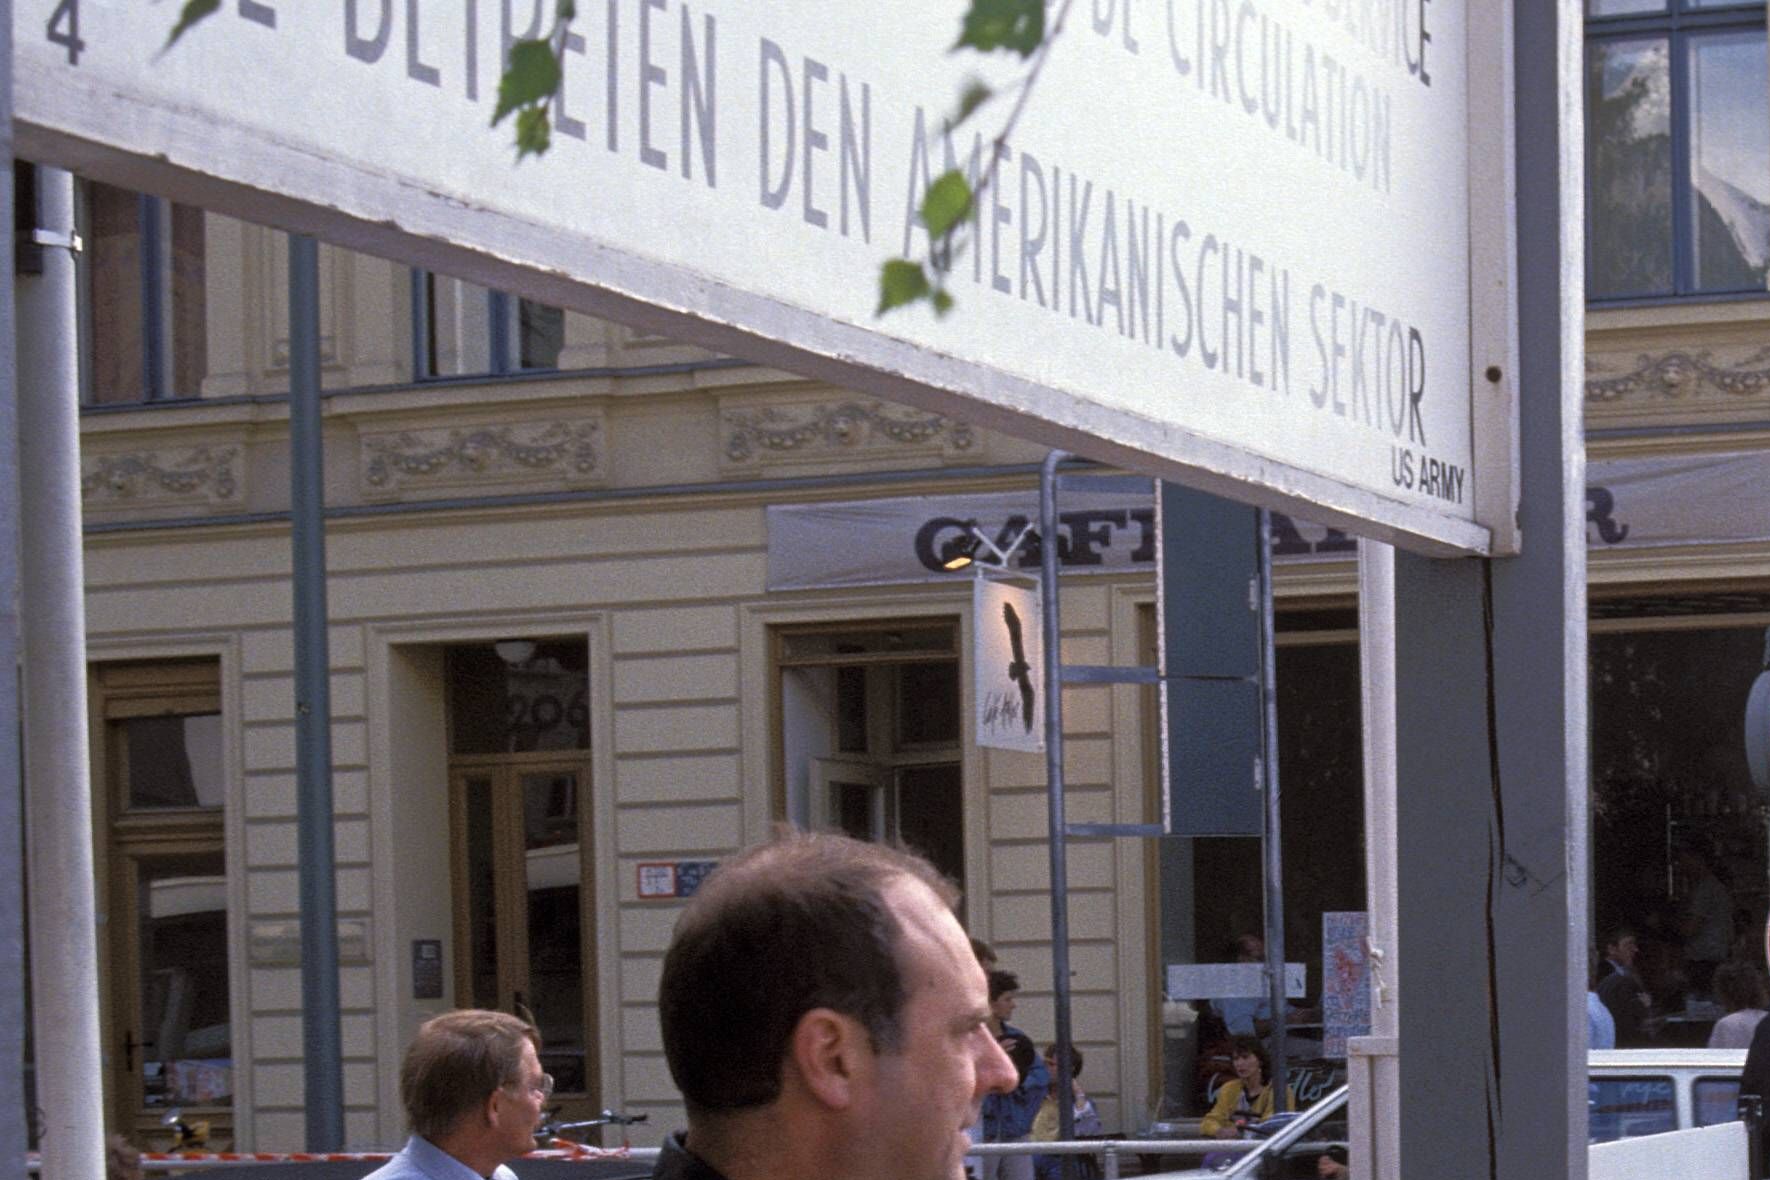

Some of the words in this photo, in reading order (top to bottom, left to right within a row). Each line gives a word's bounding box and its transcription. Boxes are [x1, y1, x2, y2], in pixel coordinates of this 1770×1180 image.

[345, 0, 717, 188] ETEN
[760, 37, 871, 244] DEN
[1309, 283, 1427, 447] SEKTOR
[1392, 445, 1414, 489] US
[1419, 454, 1464, 504] ARMY
